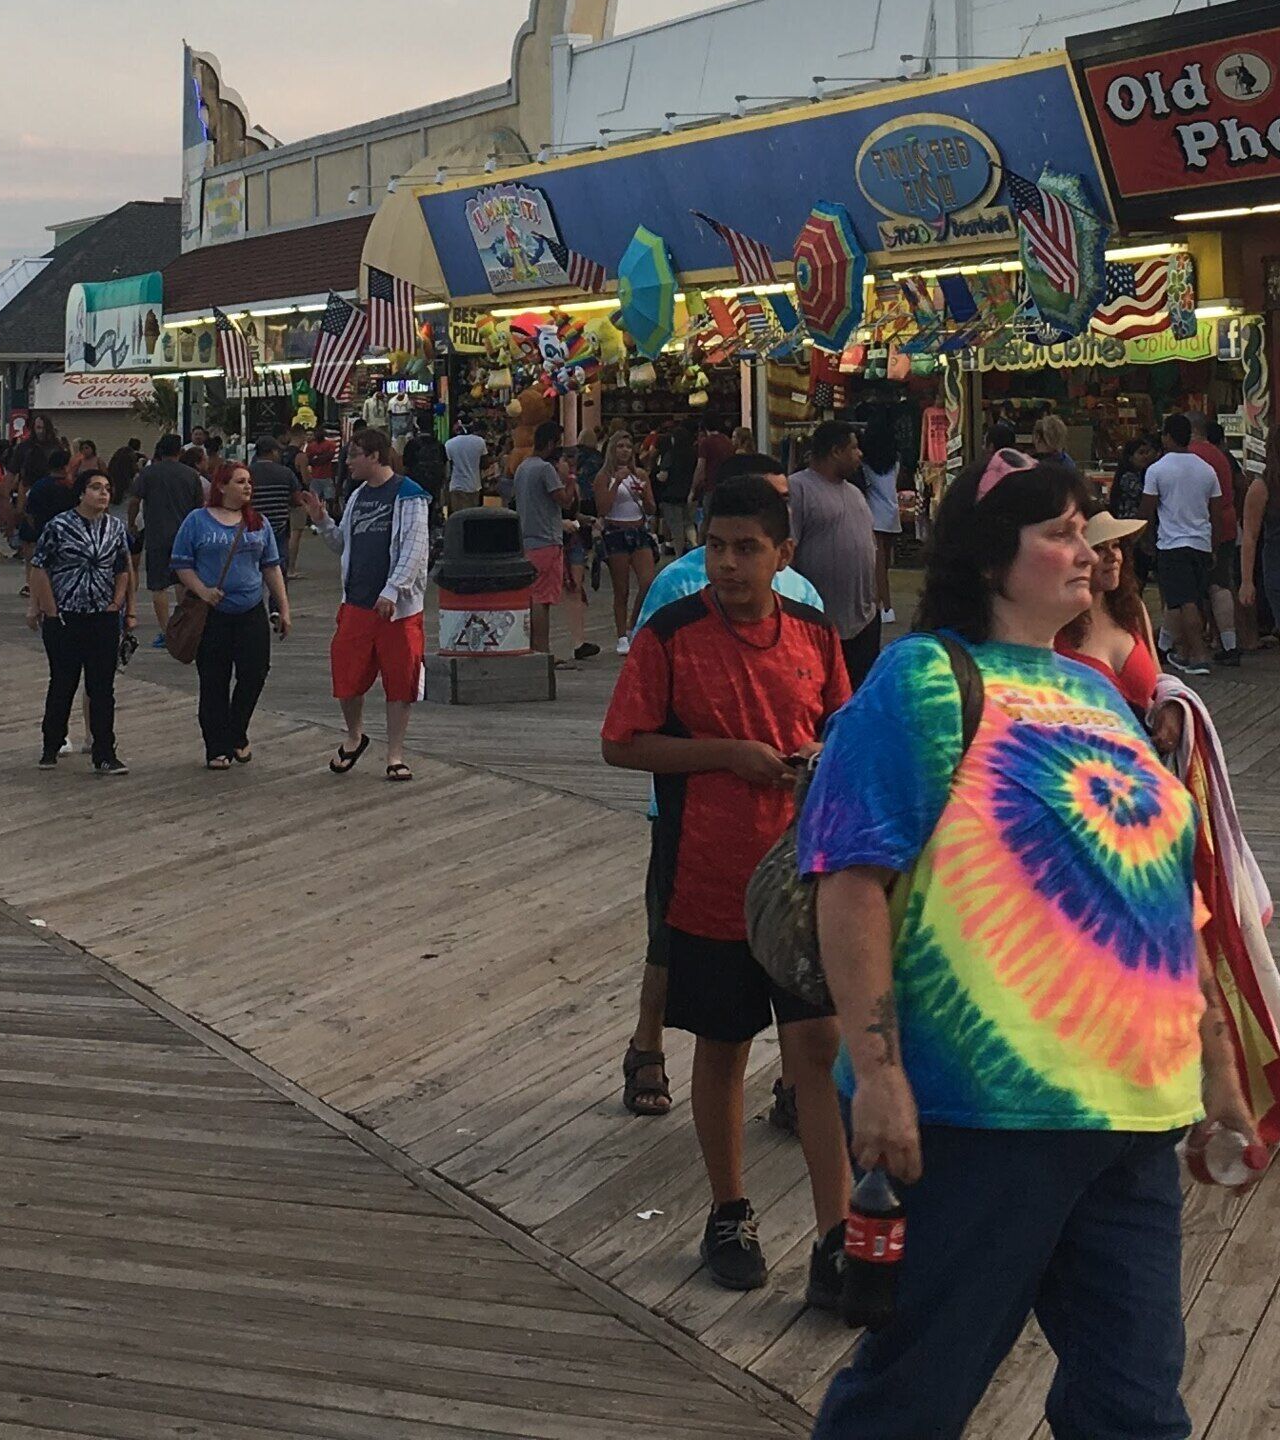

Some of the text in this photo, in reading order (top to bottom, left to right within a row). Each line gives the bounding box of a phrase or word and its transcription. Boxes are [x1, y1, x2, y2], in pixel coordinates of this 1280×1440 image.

[1105, 63, 1210, 122] Old
[453, 307, 478, 324] BES
[63, 372, 149, 387] Readings
